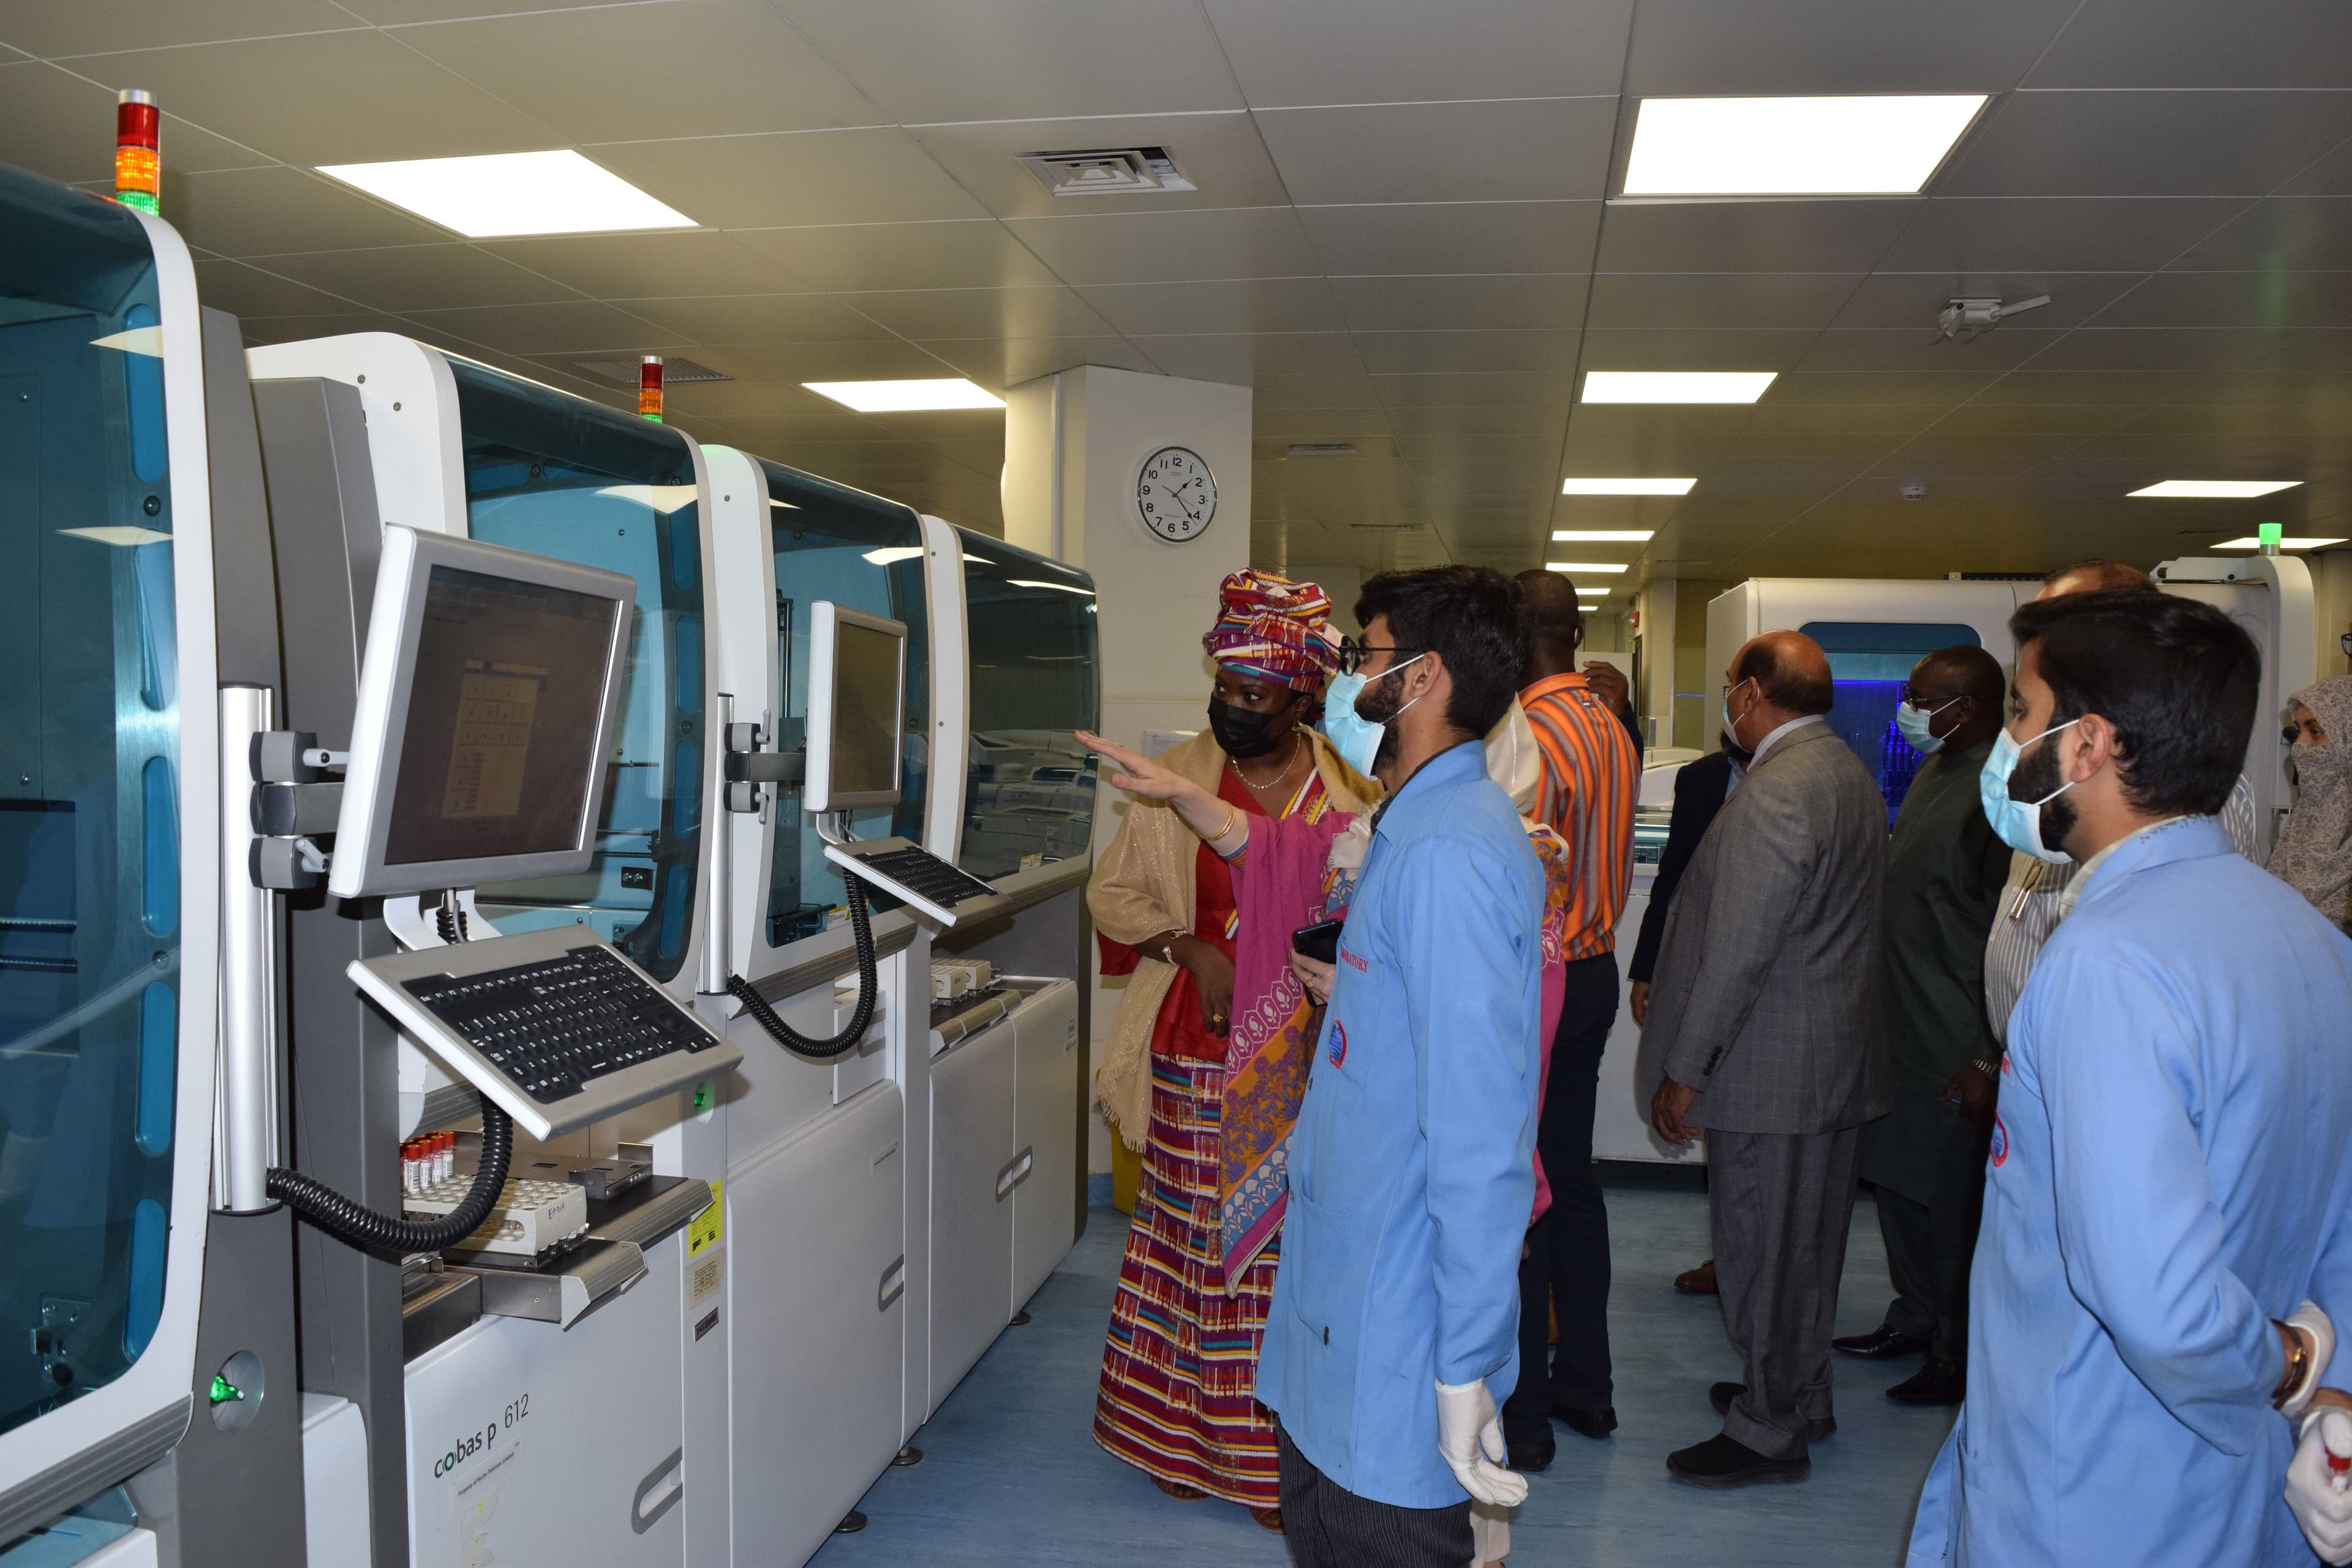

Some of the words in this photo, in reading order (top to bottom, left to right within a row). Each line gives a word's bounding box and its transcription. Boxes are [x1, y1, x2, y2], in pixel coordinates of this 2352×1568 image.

[1161, 459, 1168, 469] 11
[1172, 456, 1182, 467] 12
[1189, 465, 1193, 473] 1
[1148, 470, 1158, 479] 10
[1195, 478, 1202, 487] 2
[1142, 485, 1150, 495] 9
[1198, 495, 1205, 504] 3
[1146, 503, 1154, 512] 8
[1193, 511, 1200, 520] 4
[1155, 516, 1163, 526] 7
[1182, 521, 1189, 530] 5
[1167, 523, 1175, 533] 6
[1340, 945, 1368, 973] ABORATORY
[434, 1431, 482, 1479] cobas
[488, 1423, 497, 1450] p
[505, 1393, 529, 1428] 612
[458, 1482, 473, 1497] Property
[477, 1471, 488, 1482] Roche
[488, 1460, 502, 1474] Pakistan
[502, 1450, 514, 1464] Limited
